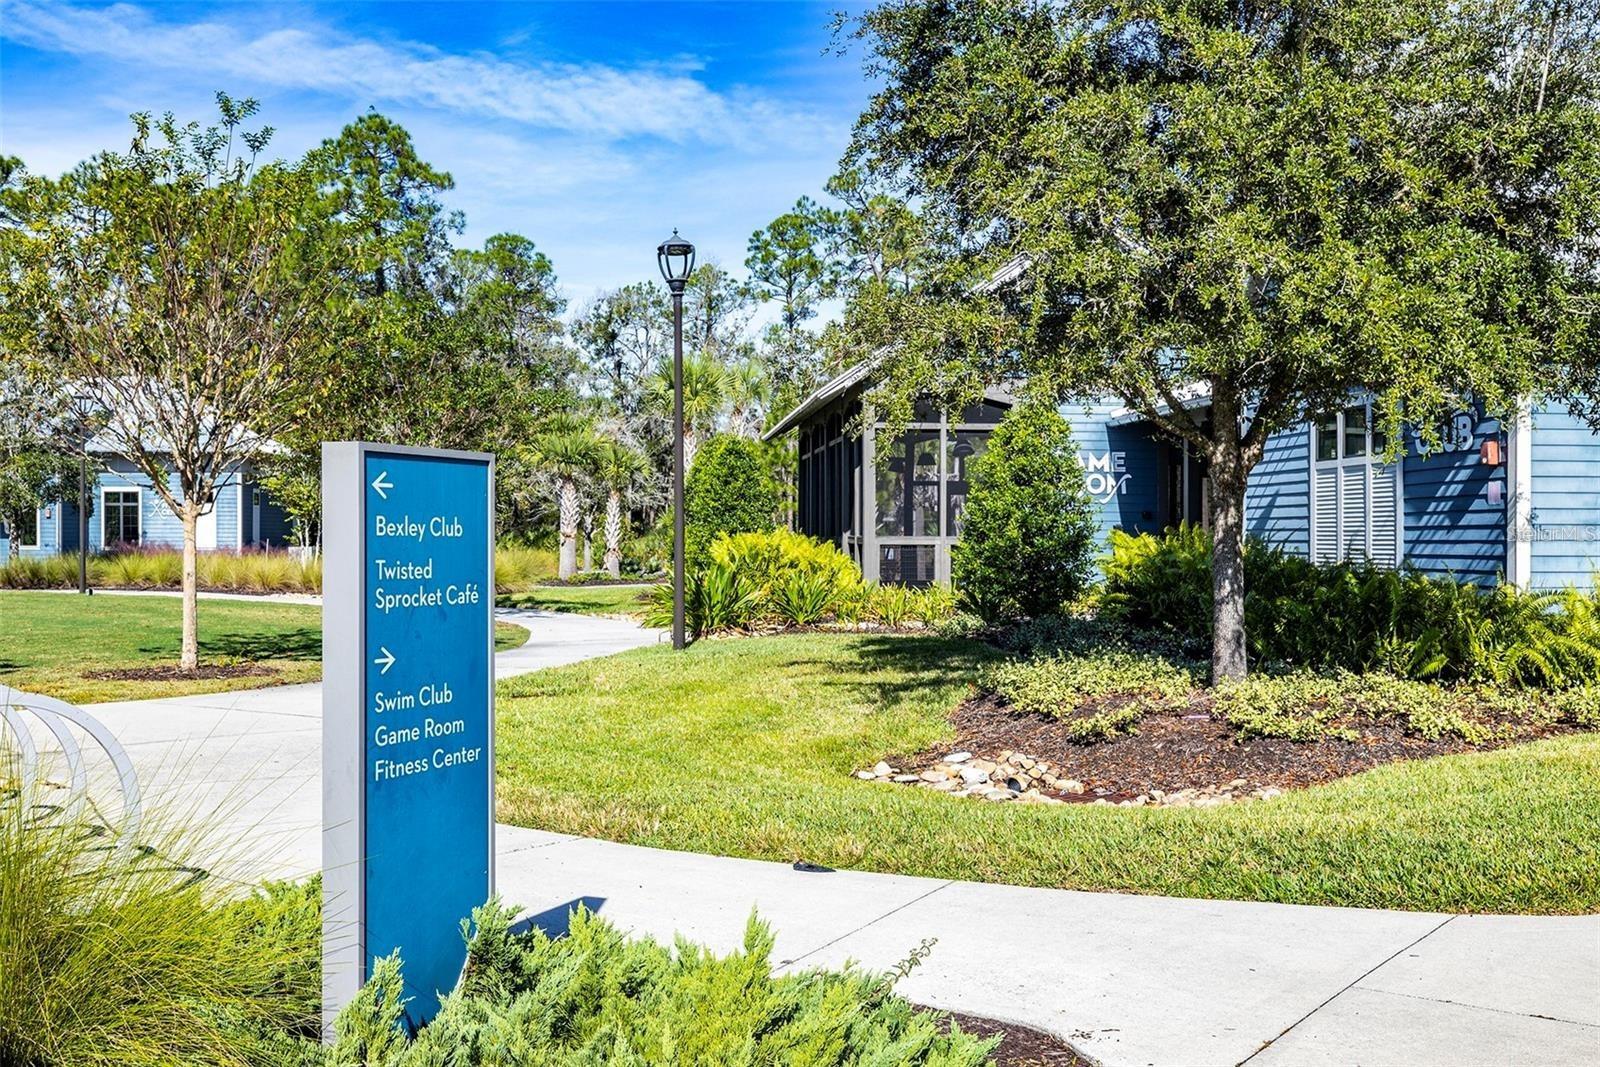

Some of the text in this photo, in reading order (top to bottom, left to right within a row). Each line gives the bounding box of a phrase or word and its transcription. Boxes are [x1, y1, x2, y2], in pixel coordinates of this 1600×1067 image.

[1073, 451, 1127, 472] AME
[1077, 473, 1132, 504] OM
[375, 515, 463, 543] Bexley Club
[375, 557, 433, 580] Twisted
[375, 583, 479, 614] Sprocket Café
[374, 682, 453, 713] Swim Club
[374, 718, 465, 747] Game Room
[375, 747, 482, 782] Fitness Center
